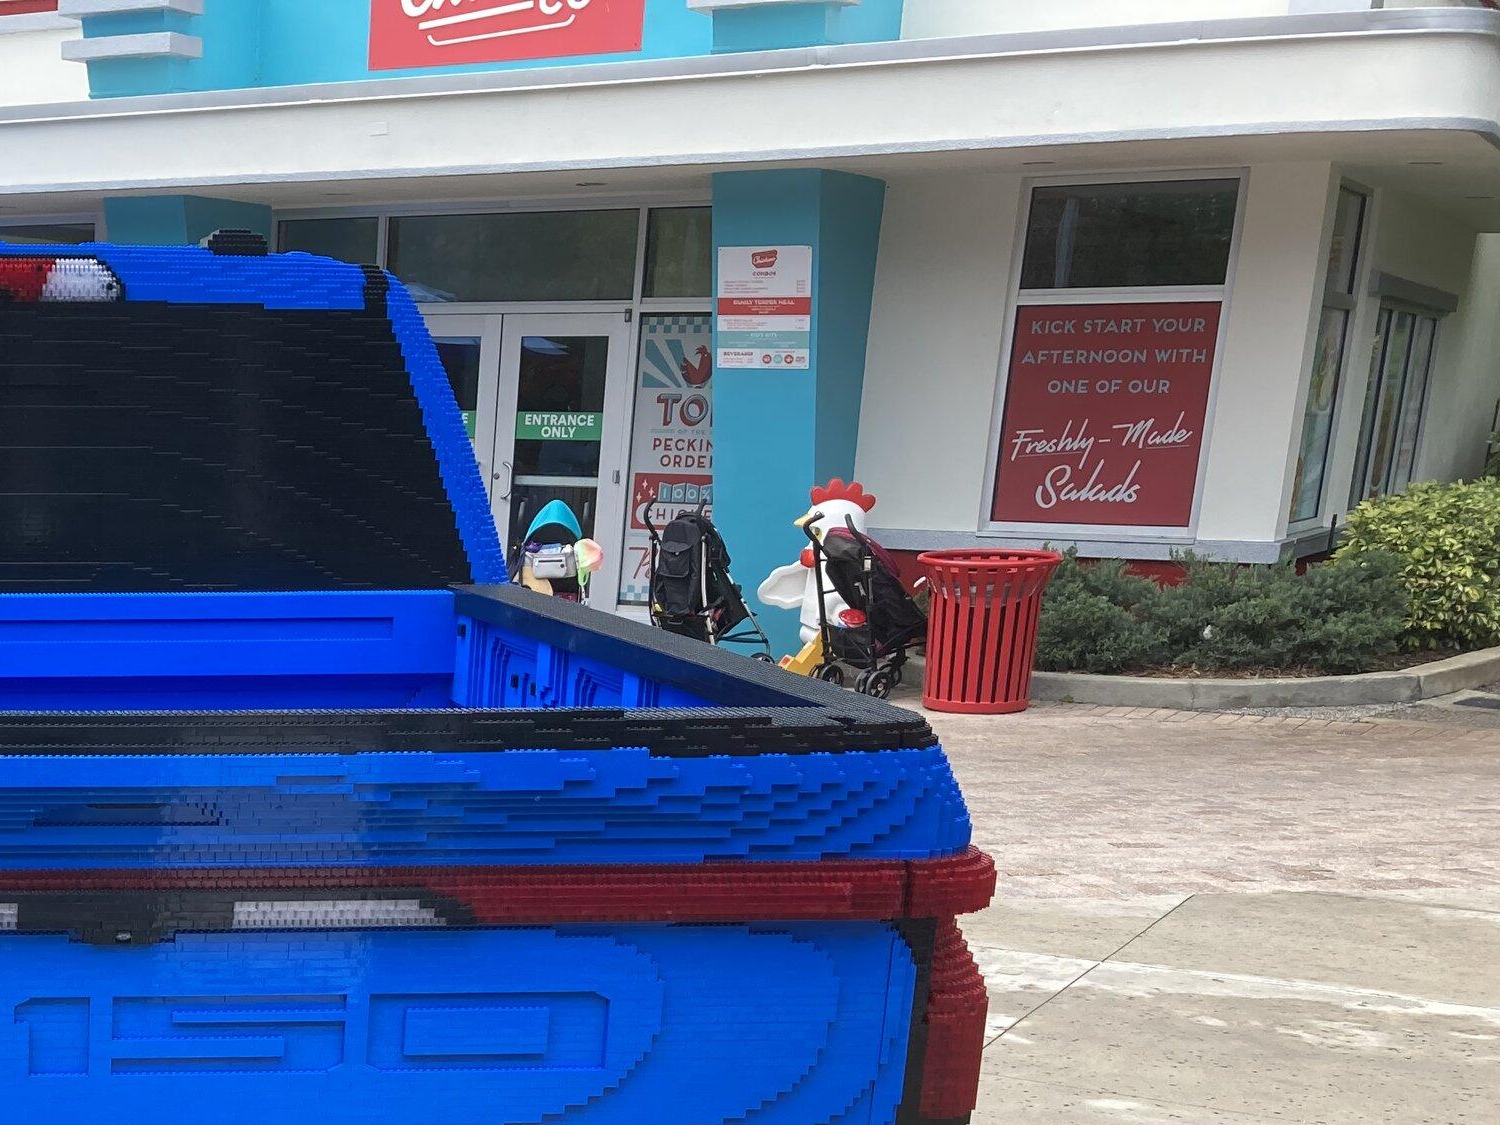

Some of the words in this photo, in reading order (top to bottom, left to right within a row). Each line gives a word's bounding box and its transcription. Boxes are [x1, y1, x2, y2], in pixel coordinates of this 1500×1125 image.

[1031, 320, 1076, 334] KICK
[1083, 319, 1145, 333] START
[1152, 318, 1206, 333] YOUR
[1021, 349, 1146, 364] AFTERNOON
[1155, 348, 1206, 363] WITH
[1047, 380, 1088, 394] ONE
[1095, 380, 1122, 394] OF
[1128, 379, 1171, 394] OUR
[657, 393, 712, 427] TO
[525, 414, 595, 426] ENTRANCE
[541, 426, 576, 438] ONLY
[652, 437, 712, 452] PECKIN
[660, 454, 712, 468] ORDE
[1035, 459, 1141, 509] Salads
